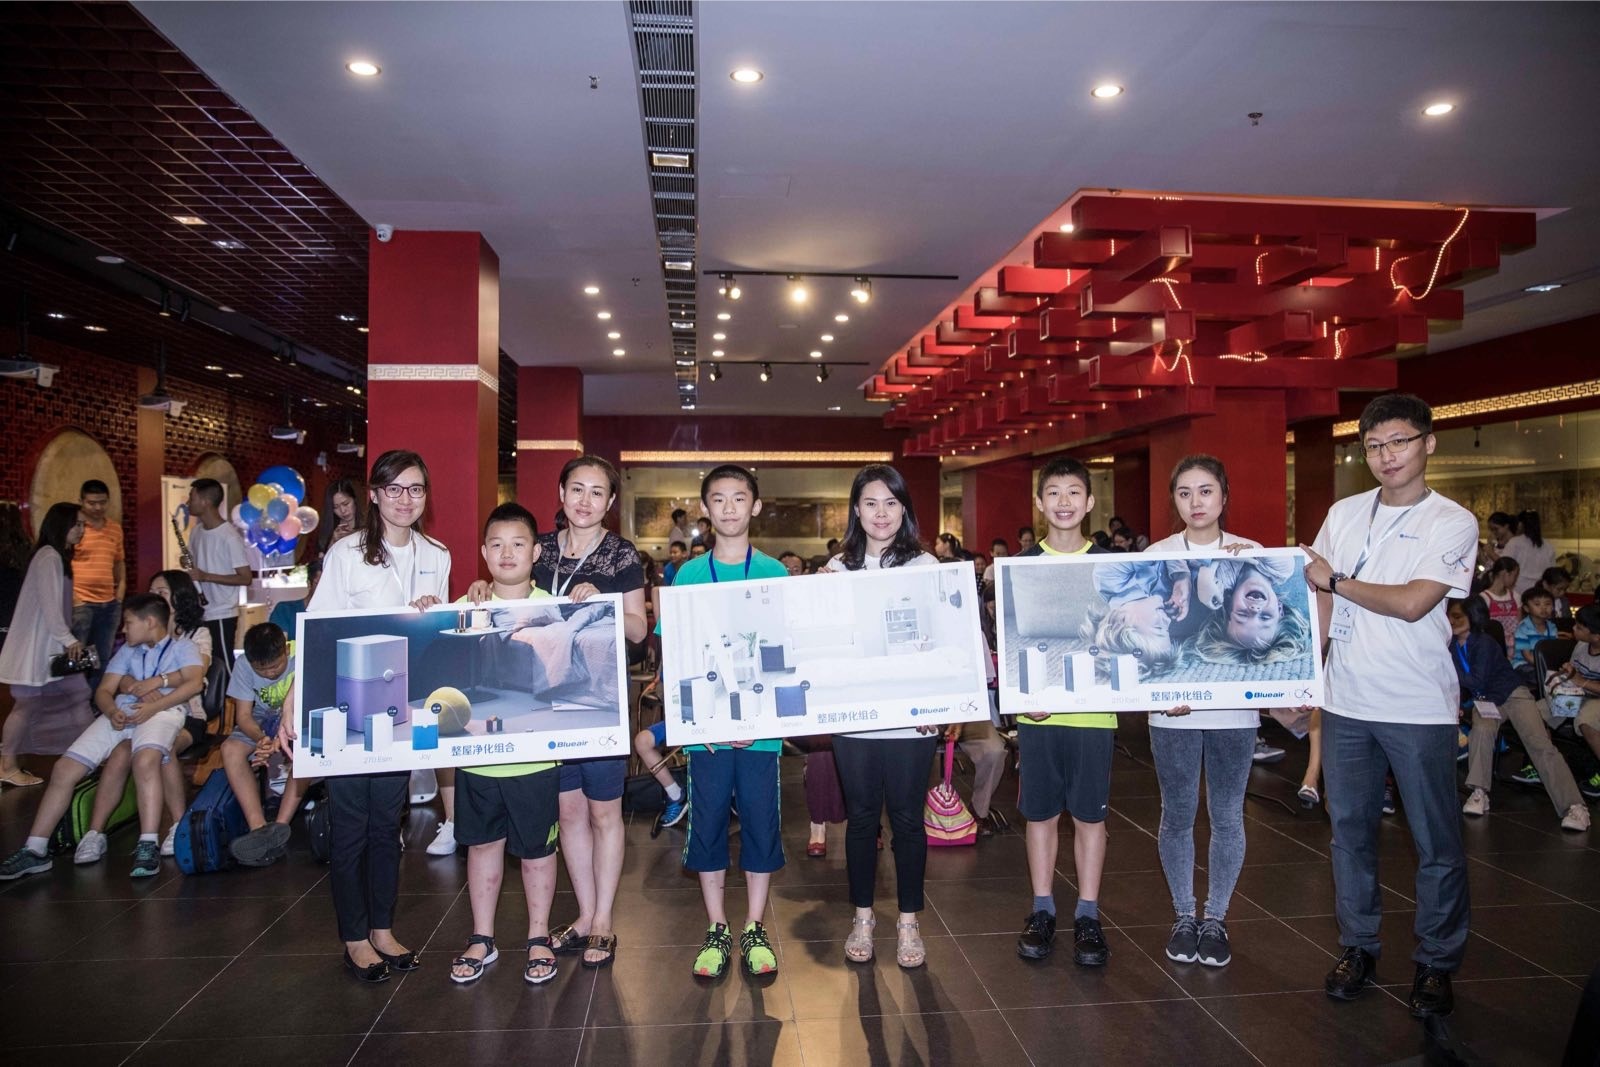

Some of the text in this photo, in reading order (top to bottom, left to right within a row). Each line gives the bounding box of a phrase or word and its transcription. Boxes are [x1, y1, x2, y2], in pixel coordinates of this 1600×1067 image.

[1151, 690, 1213, 702] 整屋净化组合
[817, 709, 879, 724] 整屋净化组合
[919, 707, 950, 715] Blueair
[451, 742, 516, 757] 整屋净化组合
[557, 740, 589, 748] Blueair
